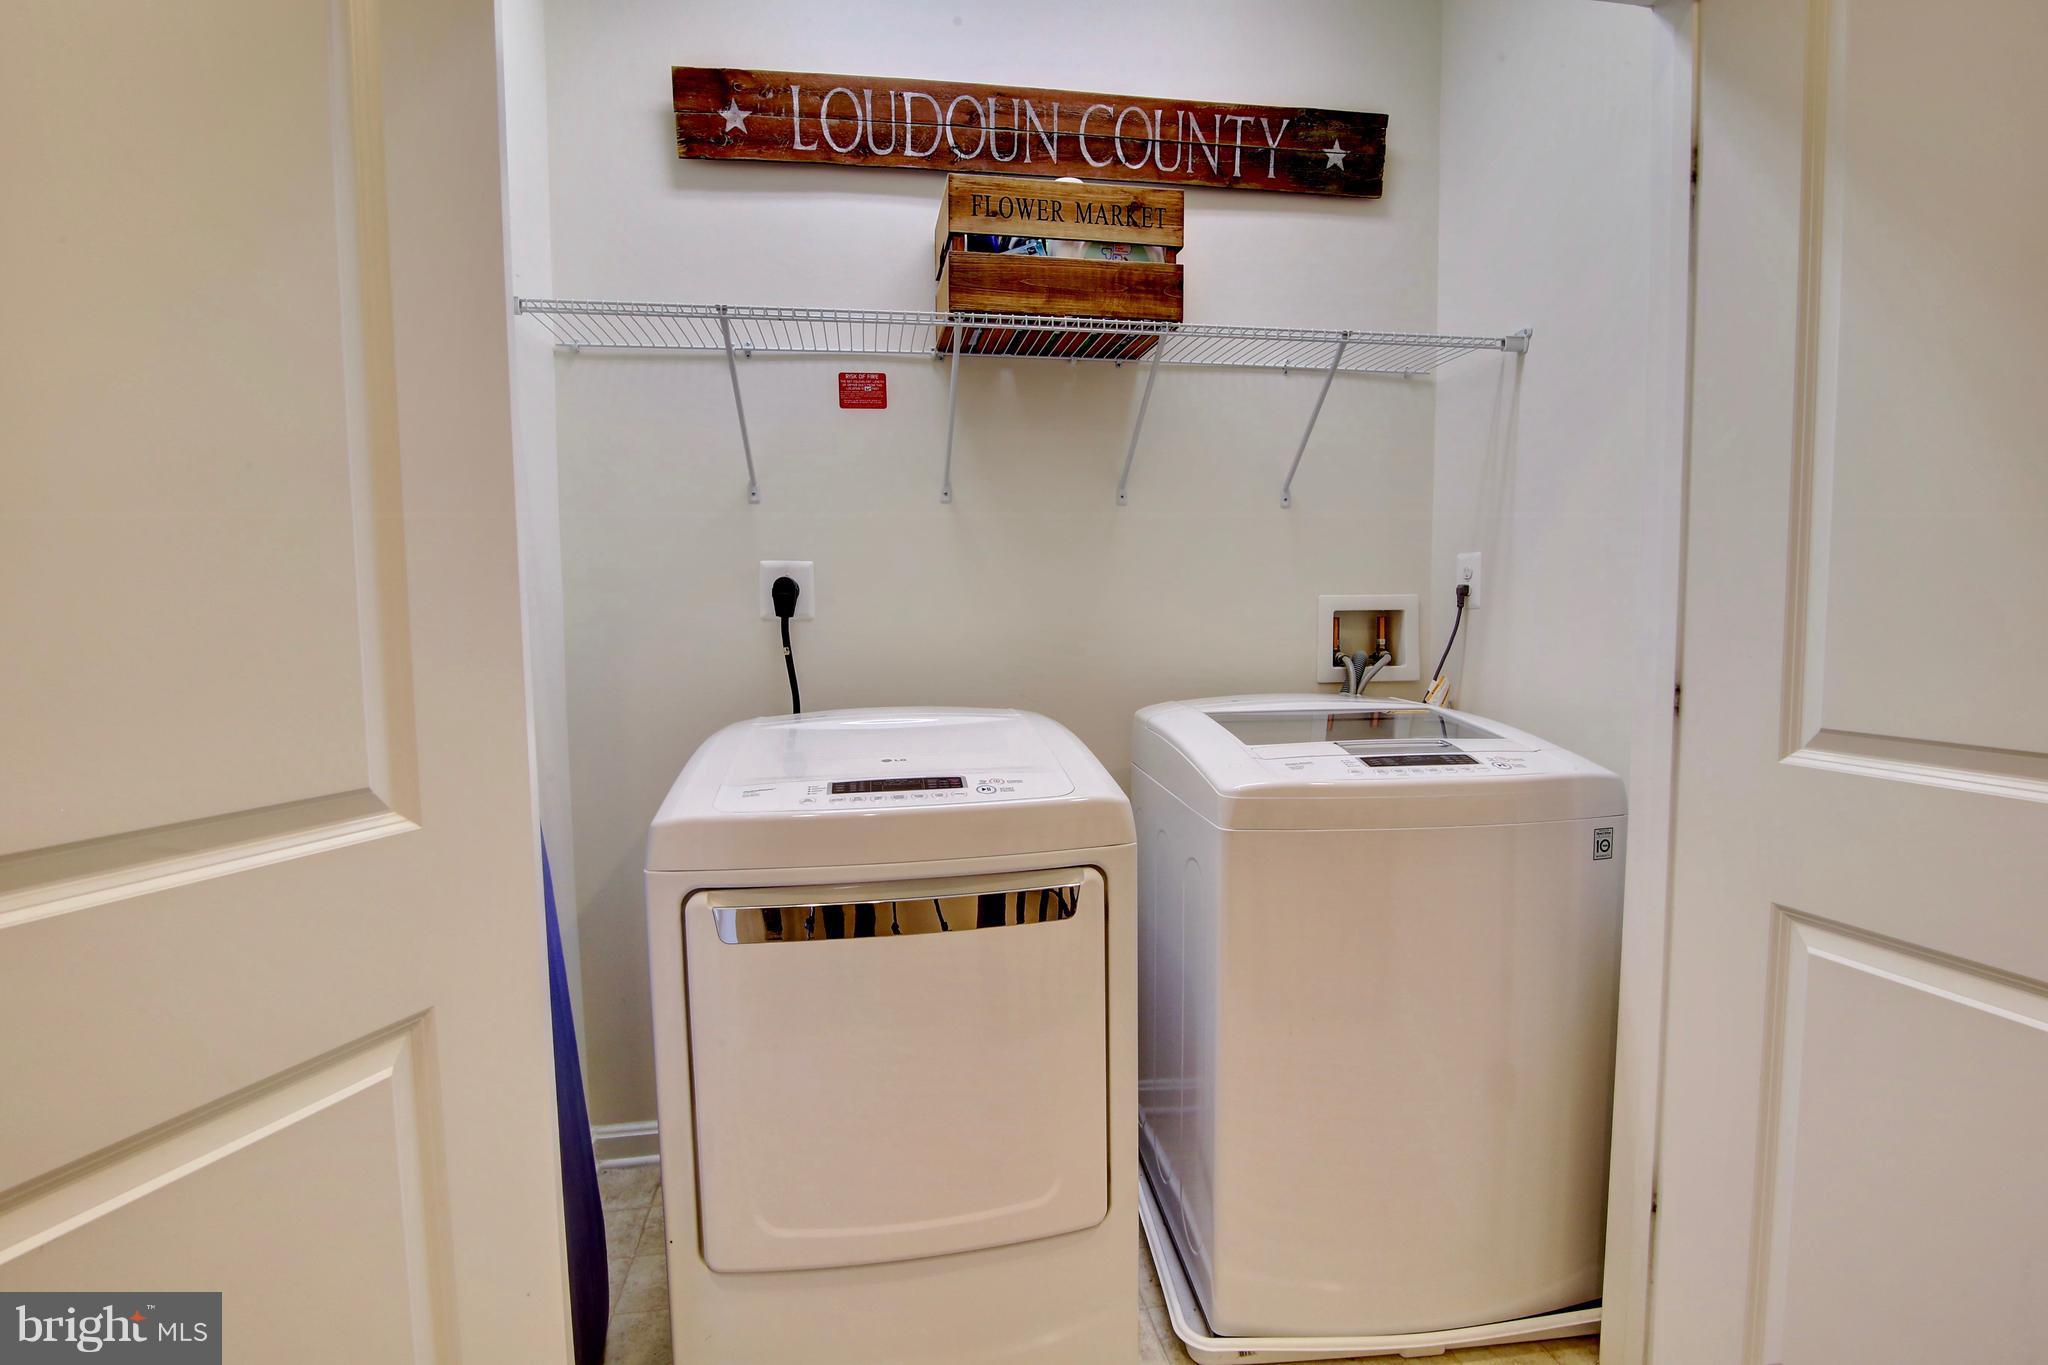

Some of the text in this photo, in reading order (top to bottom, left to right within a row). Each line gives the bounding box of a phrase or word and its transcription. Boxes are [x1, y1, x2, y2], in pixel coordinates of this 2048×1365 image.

[789, 84, 1291, 179] LOUDOUN COUNTY
[970, 193, 1167, 229] FLOWER MARKET
